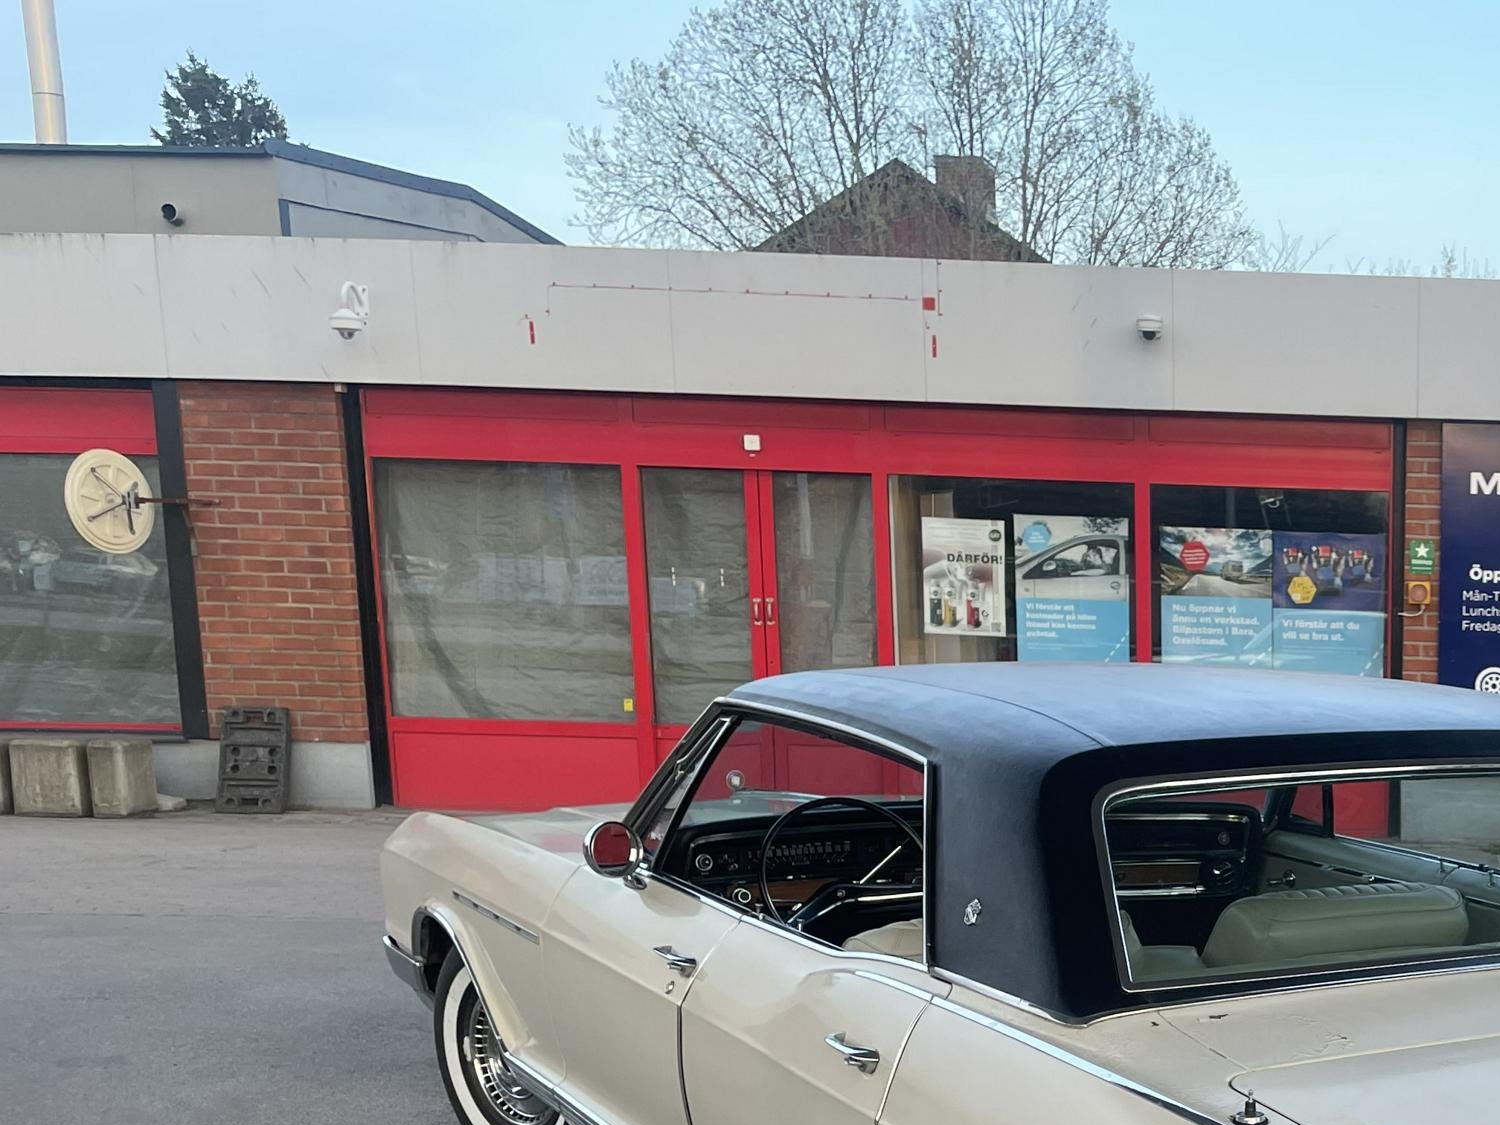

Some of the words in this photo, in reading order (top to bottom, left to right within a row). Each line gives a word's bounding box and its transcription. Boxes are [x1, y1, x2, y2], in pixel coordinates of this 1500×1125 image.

[947, 551, 1003, 565] DÄRFÖR!
[1172, 603, 1187, 612] Nu
[1188, 603, 1225, 614] öppnar
[1227, 605, 1237, 613] vi
[1199, 616, 1212, 624] en
[1214, 616, 1260, 625] verkstad.
[1282, 619, 1293, 628] Vi
[1295, 619, 1329, 629] förstår
[1330, 621, 1345, 629] att
[1346, 621, 1360, 630] du
[1282, 630, 1297, 640] vill
[1298, 632, 1310, 640] se
[1311, 631, 1329, 640] bra
[1330, 632, 1345, 641] ut.
